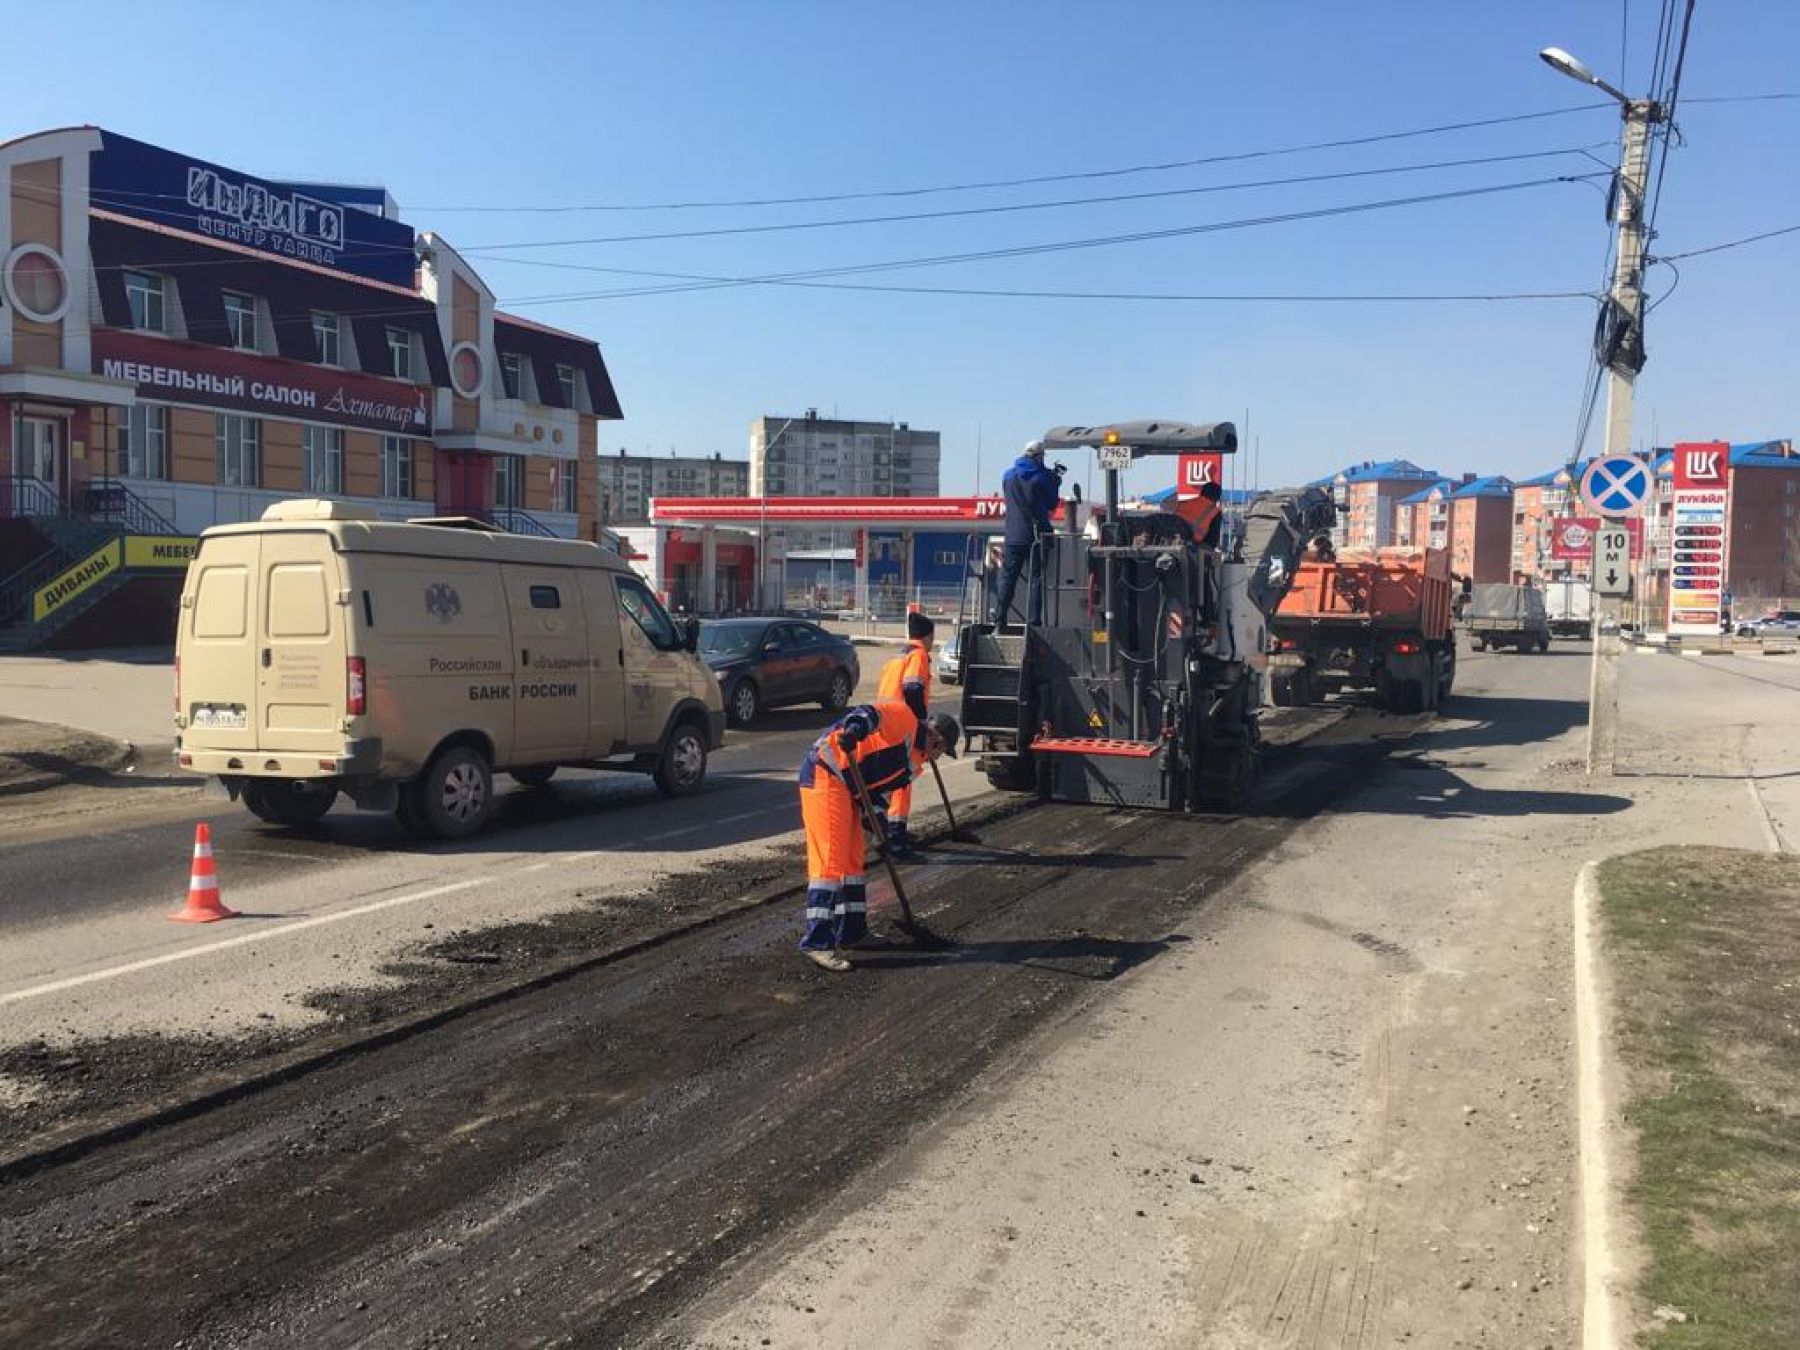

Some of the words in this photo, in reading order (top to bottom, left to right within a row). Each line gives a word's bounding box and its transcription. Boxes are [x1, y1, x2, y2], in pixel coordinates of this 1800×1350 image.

[199, 214, 266, 245] ЦЕНТР
[271, 234, 335, 265] ТАНЦА
[103, 359, 244, 397] МЕБЕЛЬНЫЙ
[251, 382, 316, 408] САЛОН
[1602, 533, 1625, 550] 10
[43, 554, 111, 608] ДИВАНЫ
[469, 685, 511, 701] БАНК
[520, 683, 577, 699] РОССИИ
